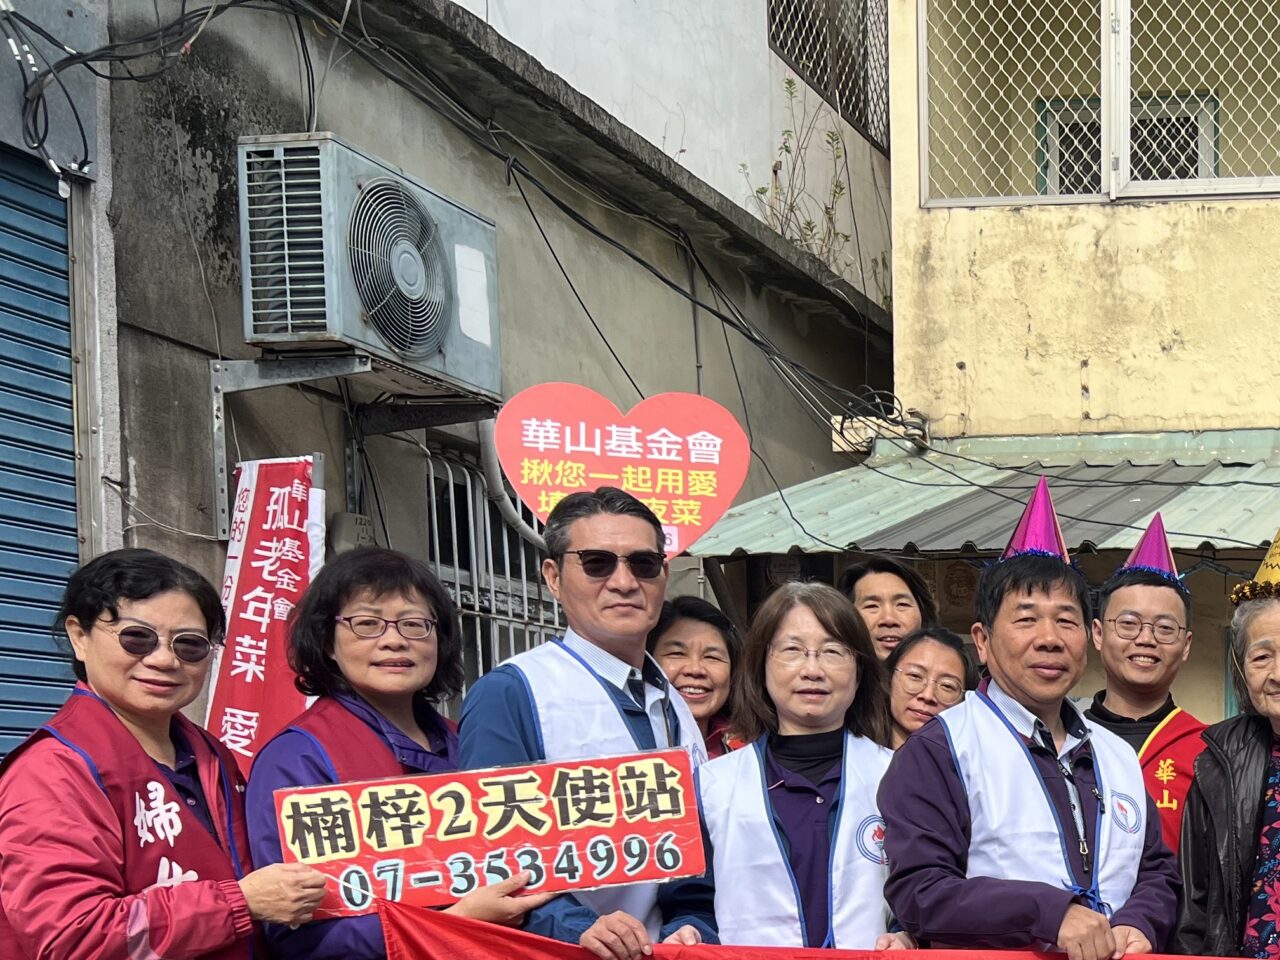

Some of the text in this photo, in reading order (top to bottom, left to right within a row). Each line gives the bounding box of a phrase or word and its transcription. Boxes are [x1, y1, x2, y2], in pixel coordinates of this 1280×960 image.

[520, 416, 724, 465] 華山基金會
[520, 457, 718, 498] 揪您一起用愛
[537, 490, 703, 527] 填夜菜
[222, 487, 251, 612] 您的一份
[271, 478, 308, 622] 華山基金會
[219, 485, 292, 758] 孤老年菜 愛
[286, 763, 682, 860] 楠梓2天使站
[1154, 758, 1178, 811] 華山
[341, 831, 682, 911] 07-3534996
